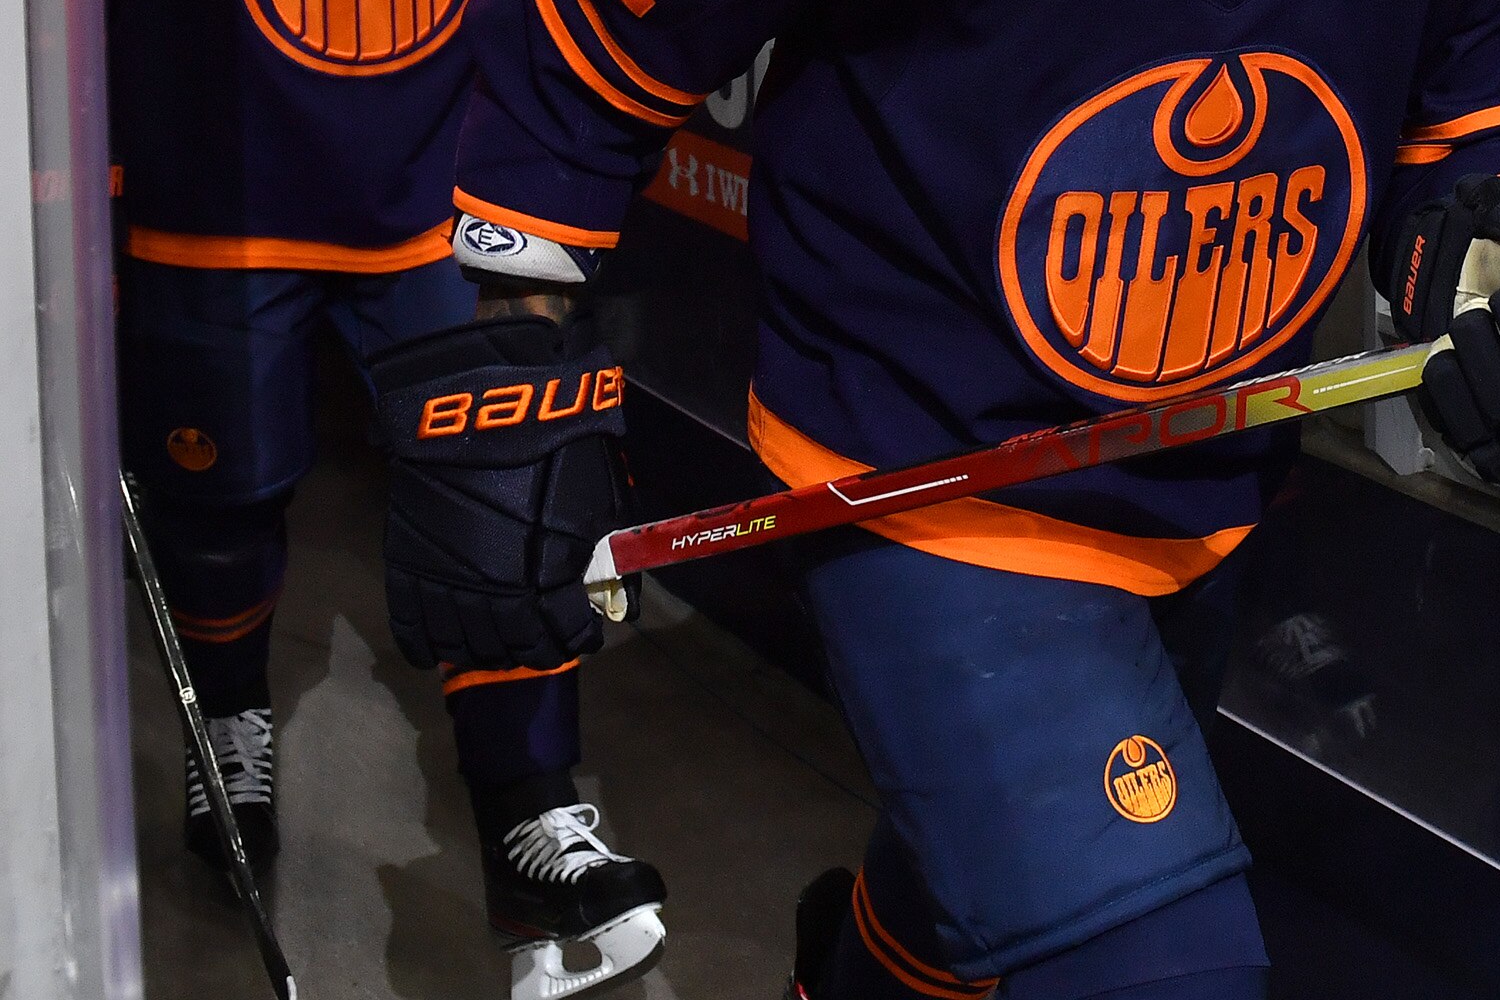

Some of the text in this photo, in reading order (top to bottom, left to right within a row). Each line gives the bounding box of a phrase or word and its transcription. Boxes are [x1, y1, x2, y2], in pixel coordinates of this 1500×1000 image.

[1046, 165, 1326, 383] OILERS
[1403, 234, 1426, 316] BAUER
[417, 366, 625, 440] BAUE
[671, 515, 777, 551] HYPERLITE
[1113, 761, 1172, 818] OILERS
